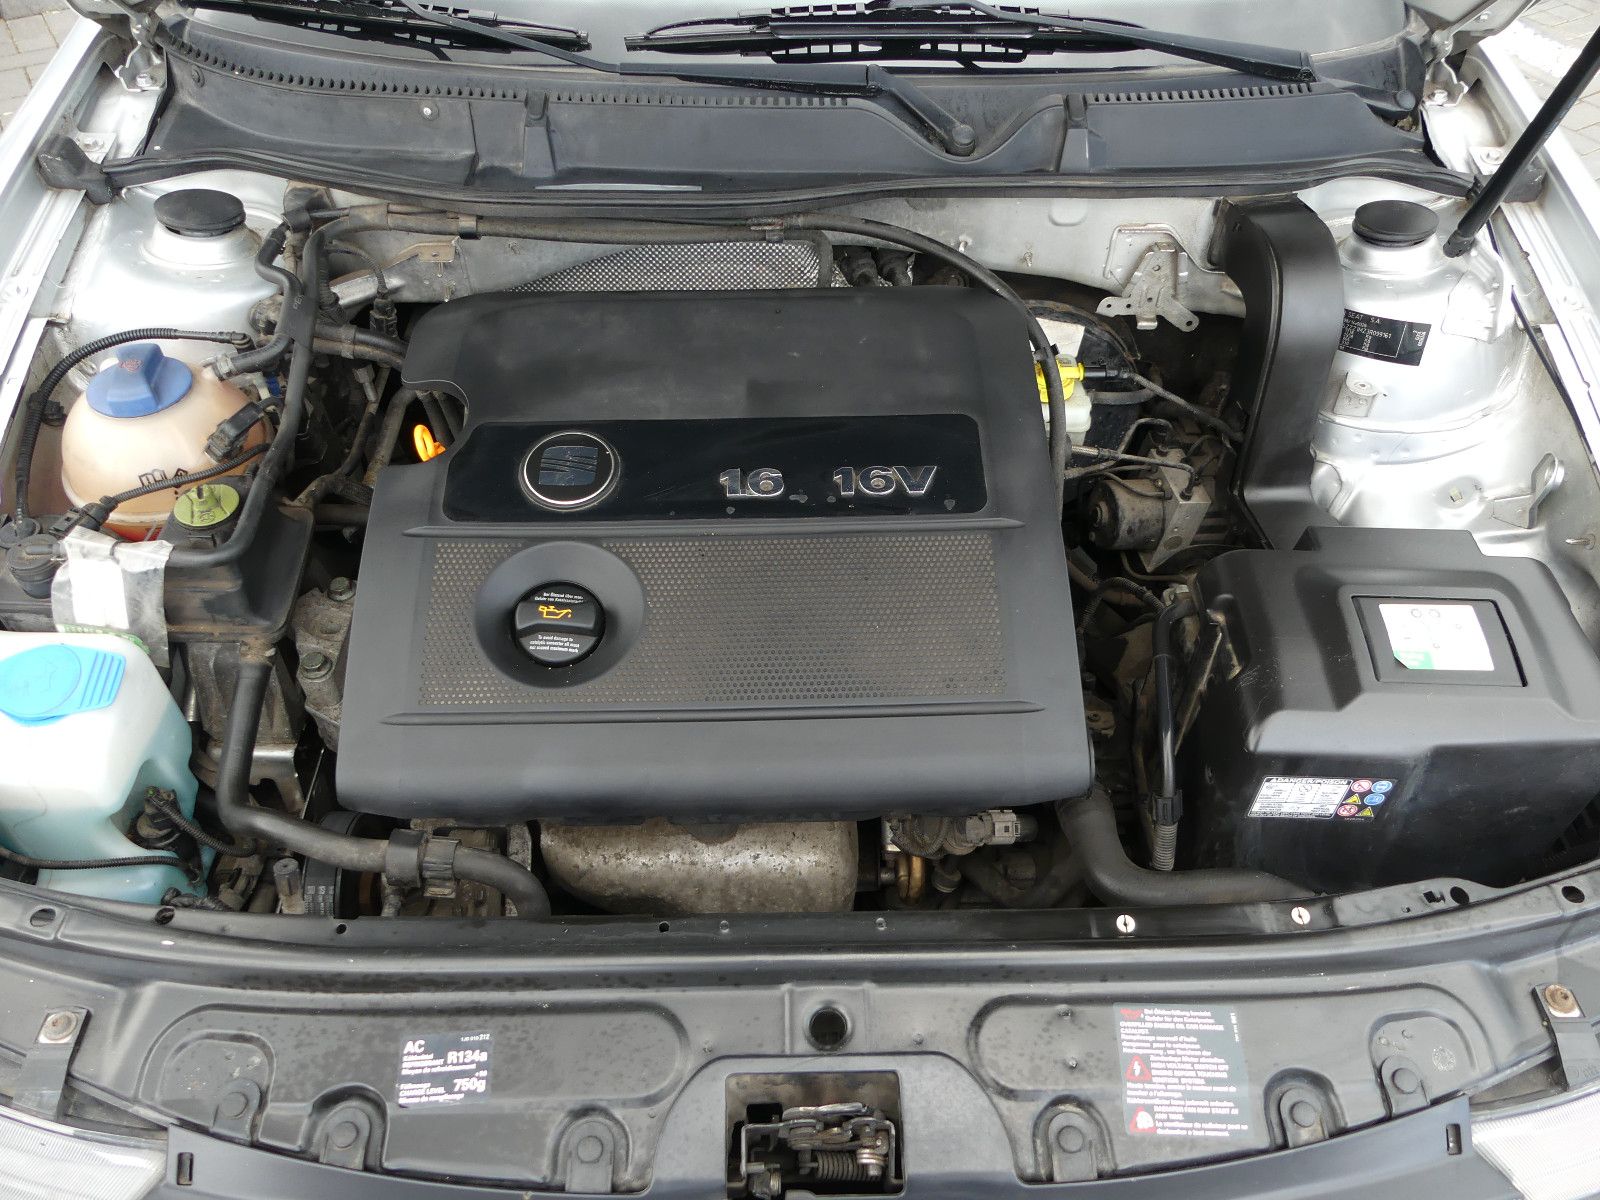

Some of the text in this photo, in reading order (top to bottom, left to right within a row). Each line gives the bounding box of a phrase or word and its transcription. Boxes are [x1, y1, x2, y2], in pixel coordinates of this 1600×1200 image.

[1348, 311, 1363, 320] SEAT
[833, 465, 938, 496] 16V
[403, 1040, 425, 1054] AC
[447, 1050, 487, 1064] R134a
[454, 1077, 486, 1092] 750g
